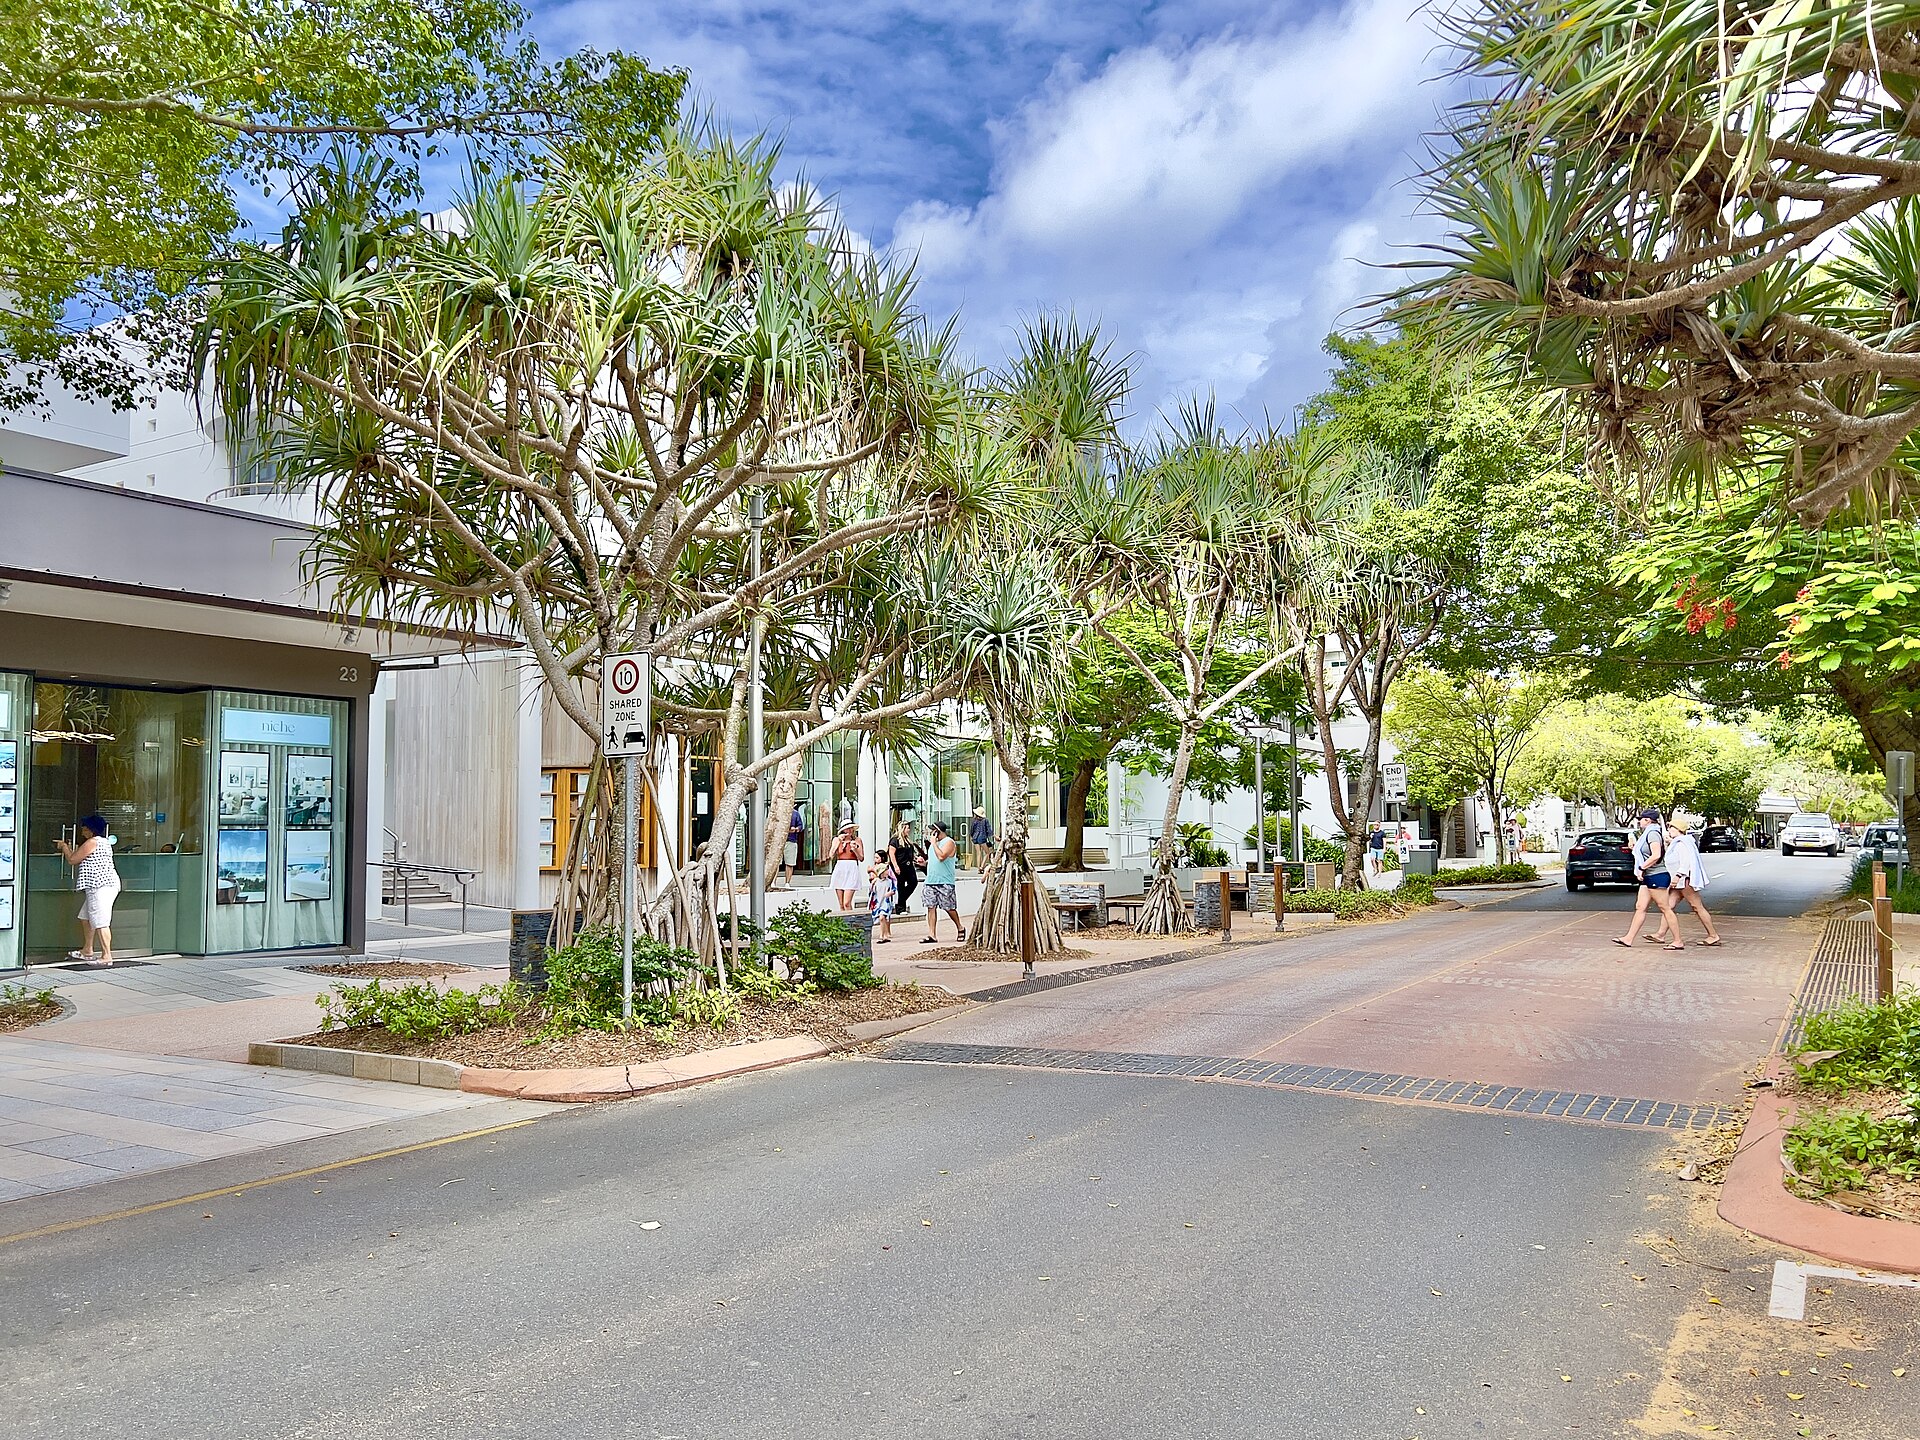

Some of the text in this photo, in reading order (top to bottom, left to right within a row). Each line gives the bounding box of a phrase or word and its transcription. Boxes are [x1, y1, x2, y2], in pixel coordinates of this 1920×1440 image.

[339, 666, 358, 682] 23
[619, 670, 632, 686] 10
[609, 698, 642, 709] SHARED
[615, 711, 636, 721] ZONE
[261, 720, 296, 733] niche
[1386, 767, 1401, 775] END
